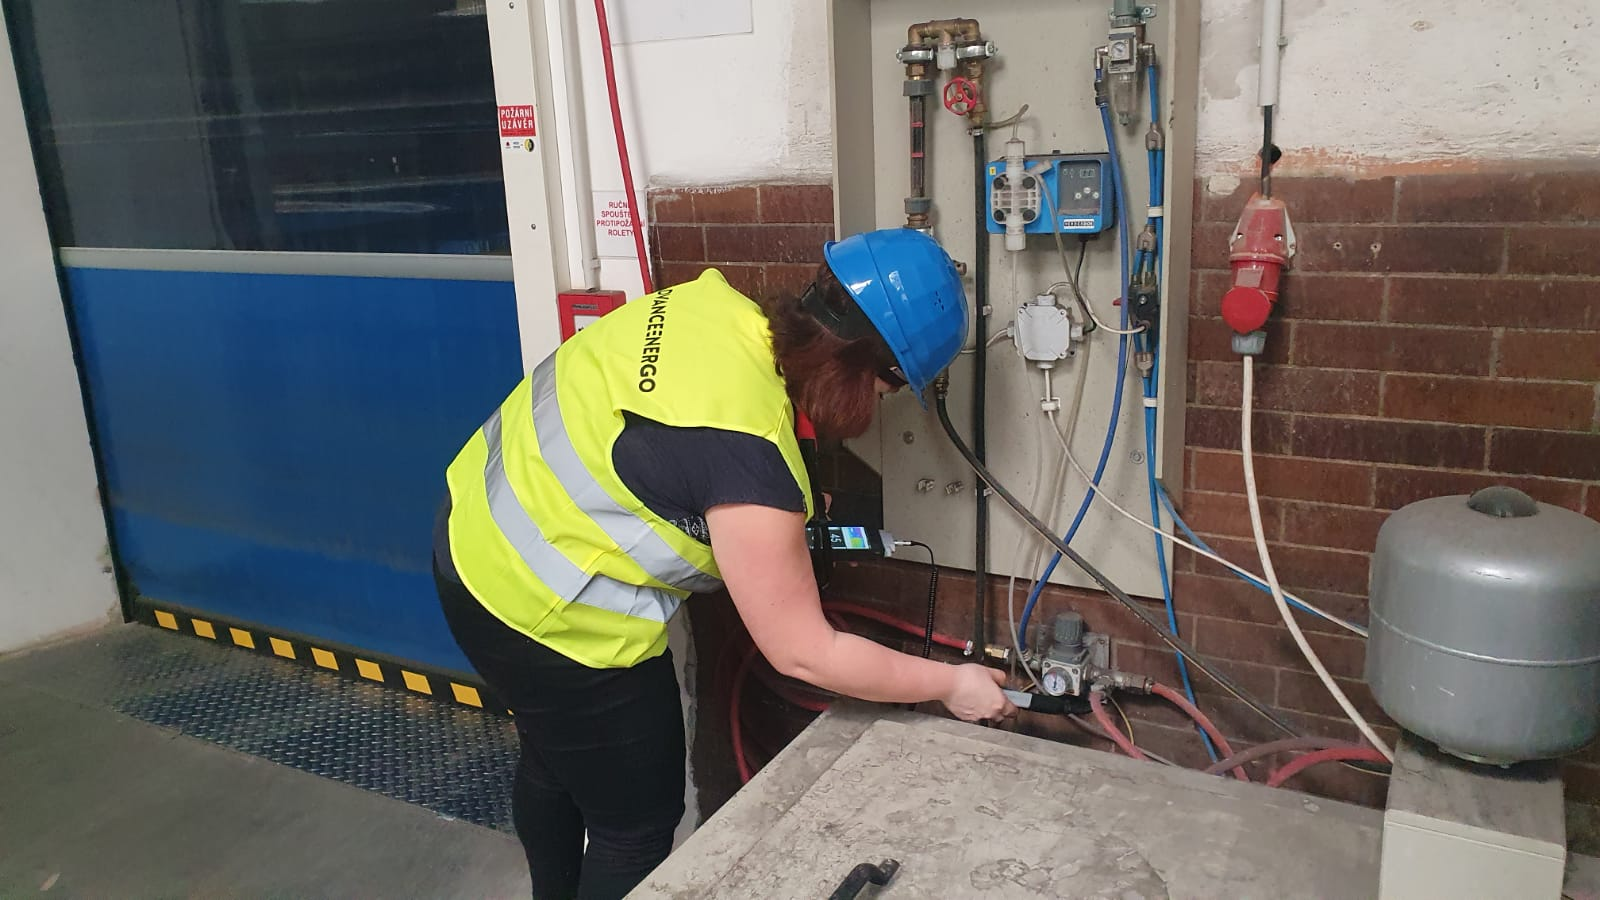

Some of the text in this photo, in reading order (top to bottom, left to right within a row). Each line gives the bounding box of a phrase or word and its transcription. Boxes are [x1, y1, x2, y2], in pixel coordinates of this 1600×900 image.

[500, 106, 533, 118] POŽÁRNÍ
[501, 117, 534, 129] UZÁVĚR
[608, 200, 628, 209] RUČN
[596, 219, 645, 227] PROTIPOŽÍ
[638, 289, 673, 393] DVANCEENERGO
